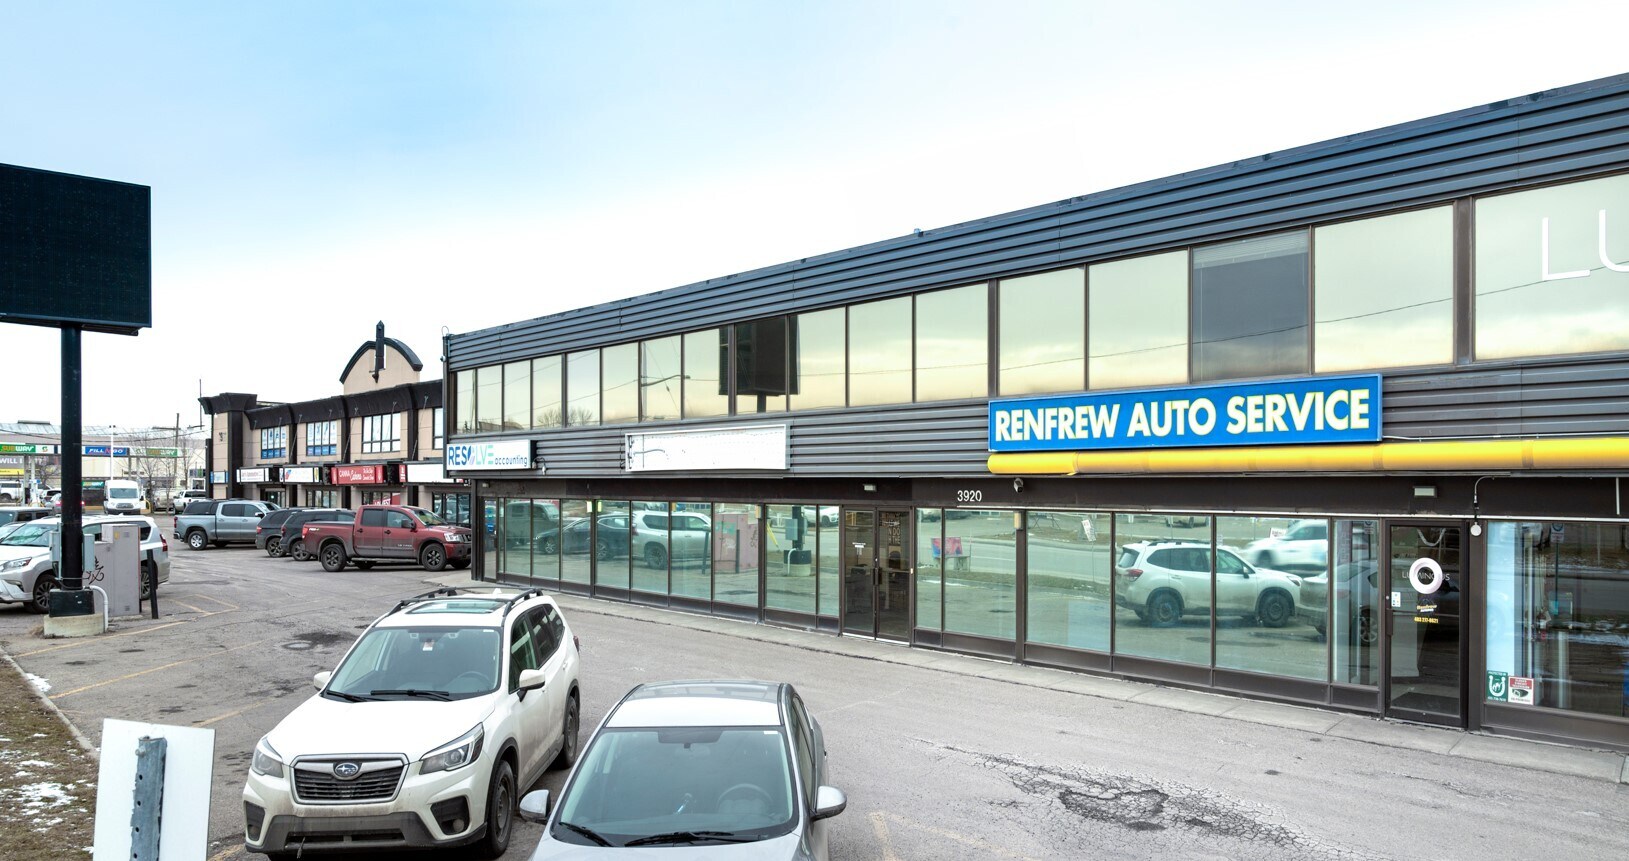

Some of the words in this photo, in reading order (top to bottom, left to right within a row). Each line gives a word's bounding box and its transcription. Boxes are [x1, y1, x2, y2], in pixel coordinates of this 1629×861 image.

[995, 403, 1120, 442] RENFREW
[1126, 397, 1217, 438] AUTO
[1226, 388, 1370, 435] SERVICE
[2, 445, 35, 453] SUBWAY
[448, 444, 494, 466] RESOLVE
[495, 455, 528, 467] accounting
[957, 489, 983, 502] 3920
